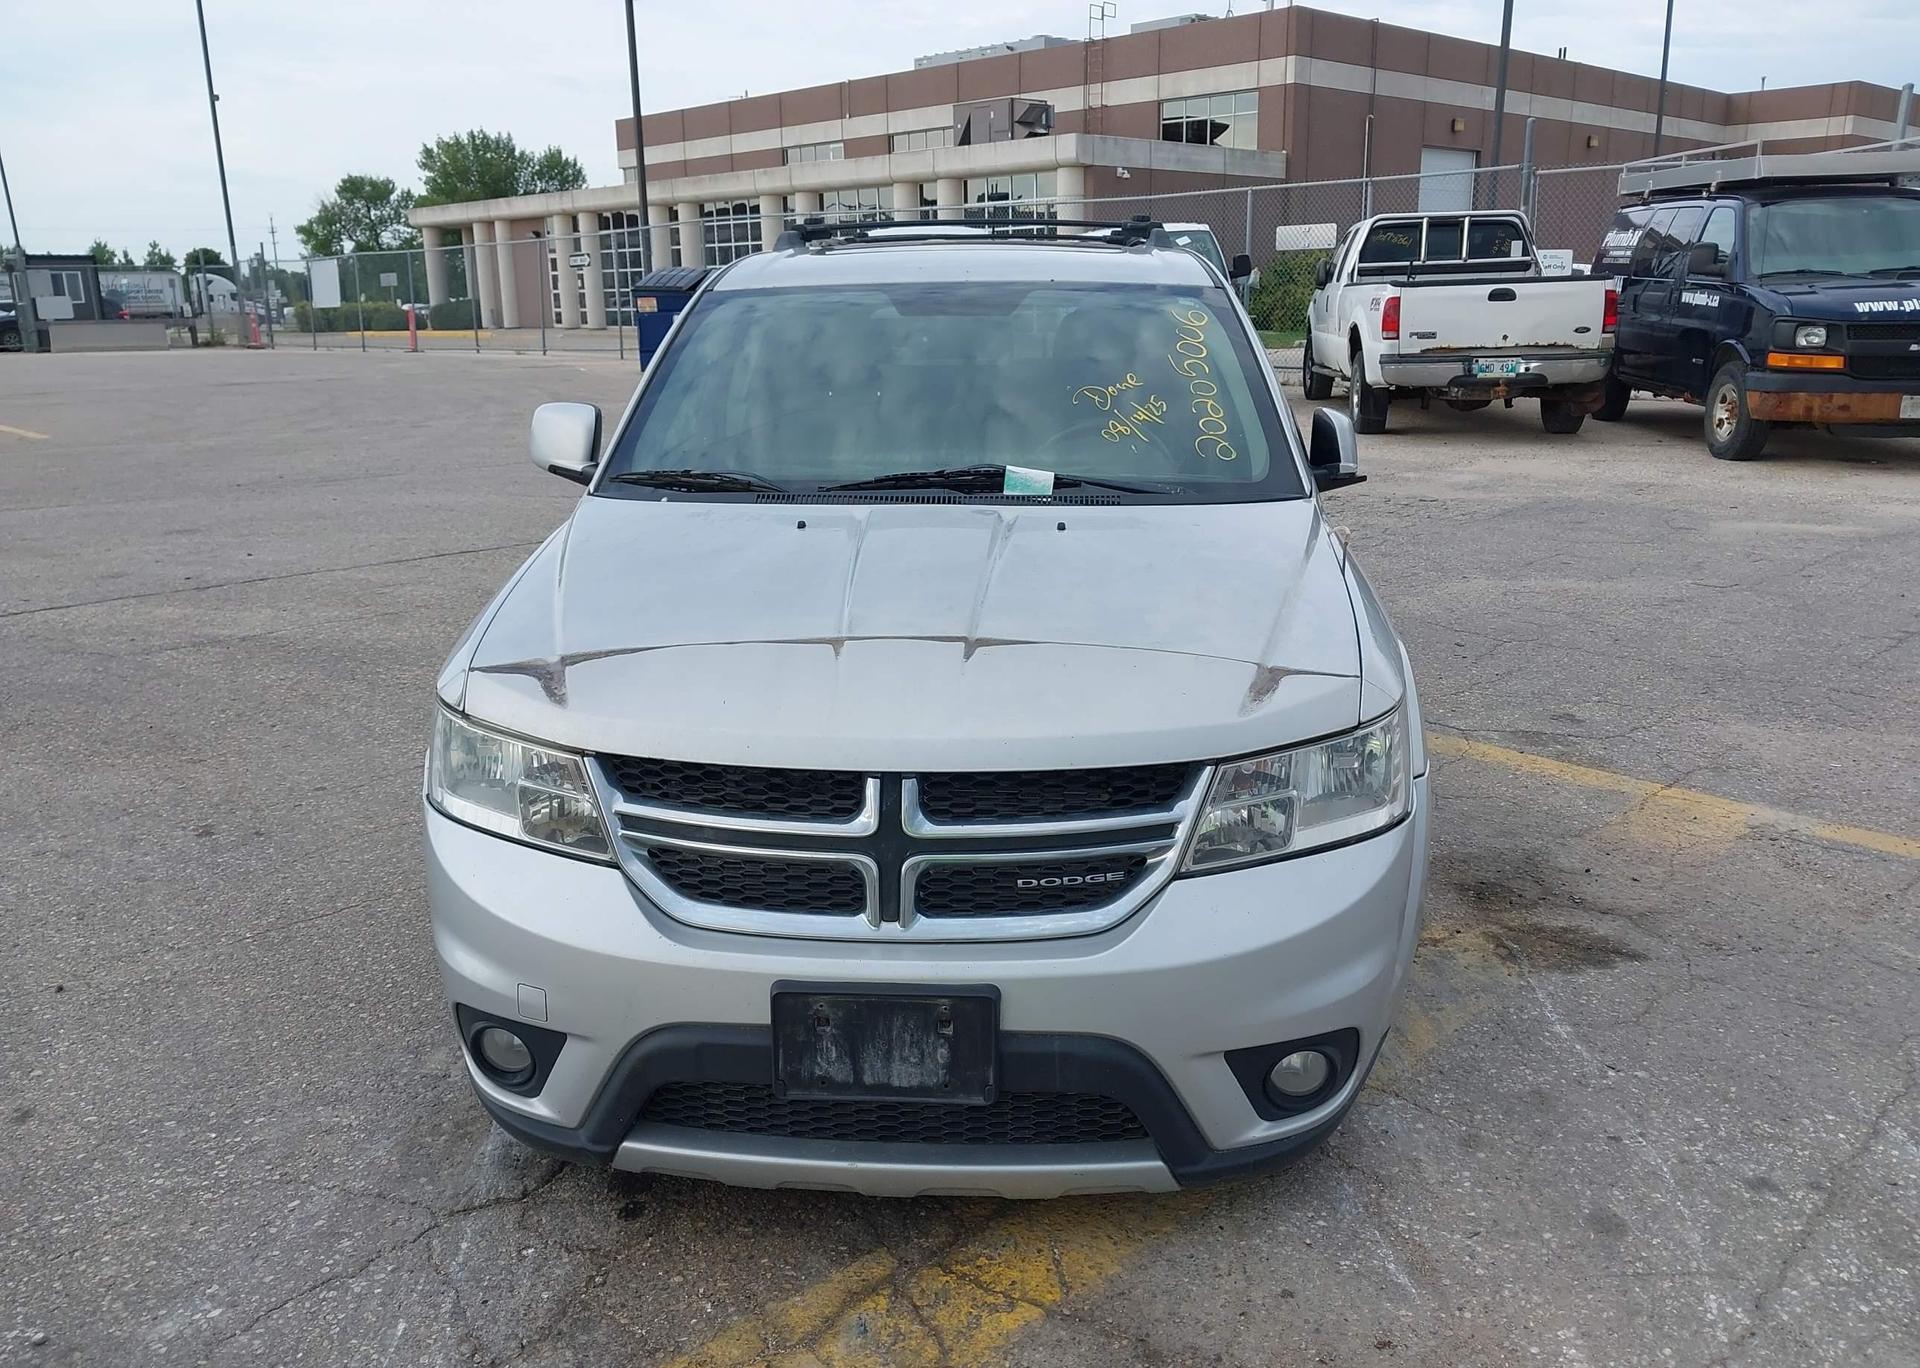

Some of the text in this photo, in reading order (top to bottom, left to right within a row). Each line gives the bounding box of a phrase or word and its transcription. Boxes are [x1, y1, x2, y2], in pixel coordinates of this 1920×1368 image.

[1552, 261, 1566, 271] Only
[1073, 373, 1143, 410] Done
[1168, 309, 1236, 460] 20205006
[1102, 395, 1166, 442] 08/14/25
[1017, 871, 1125, 888] DODGE
